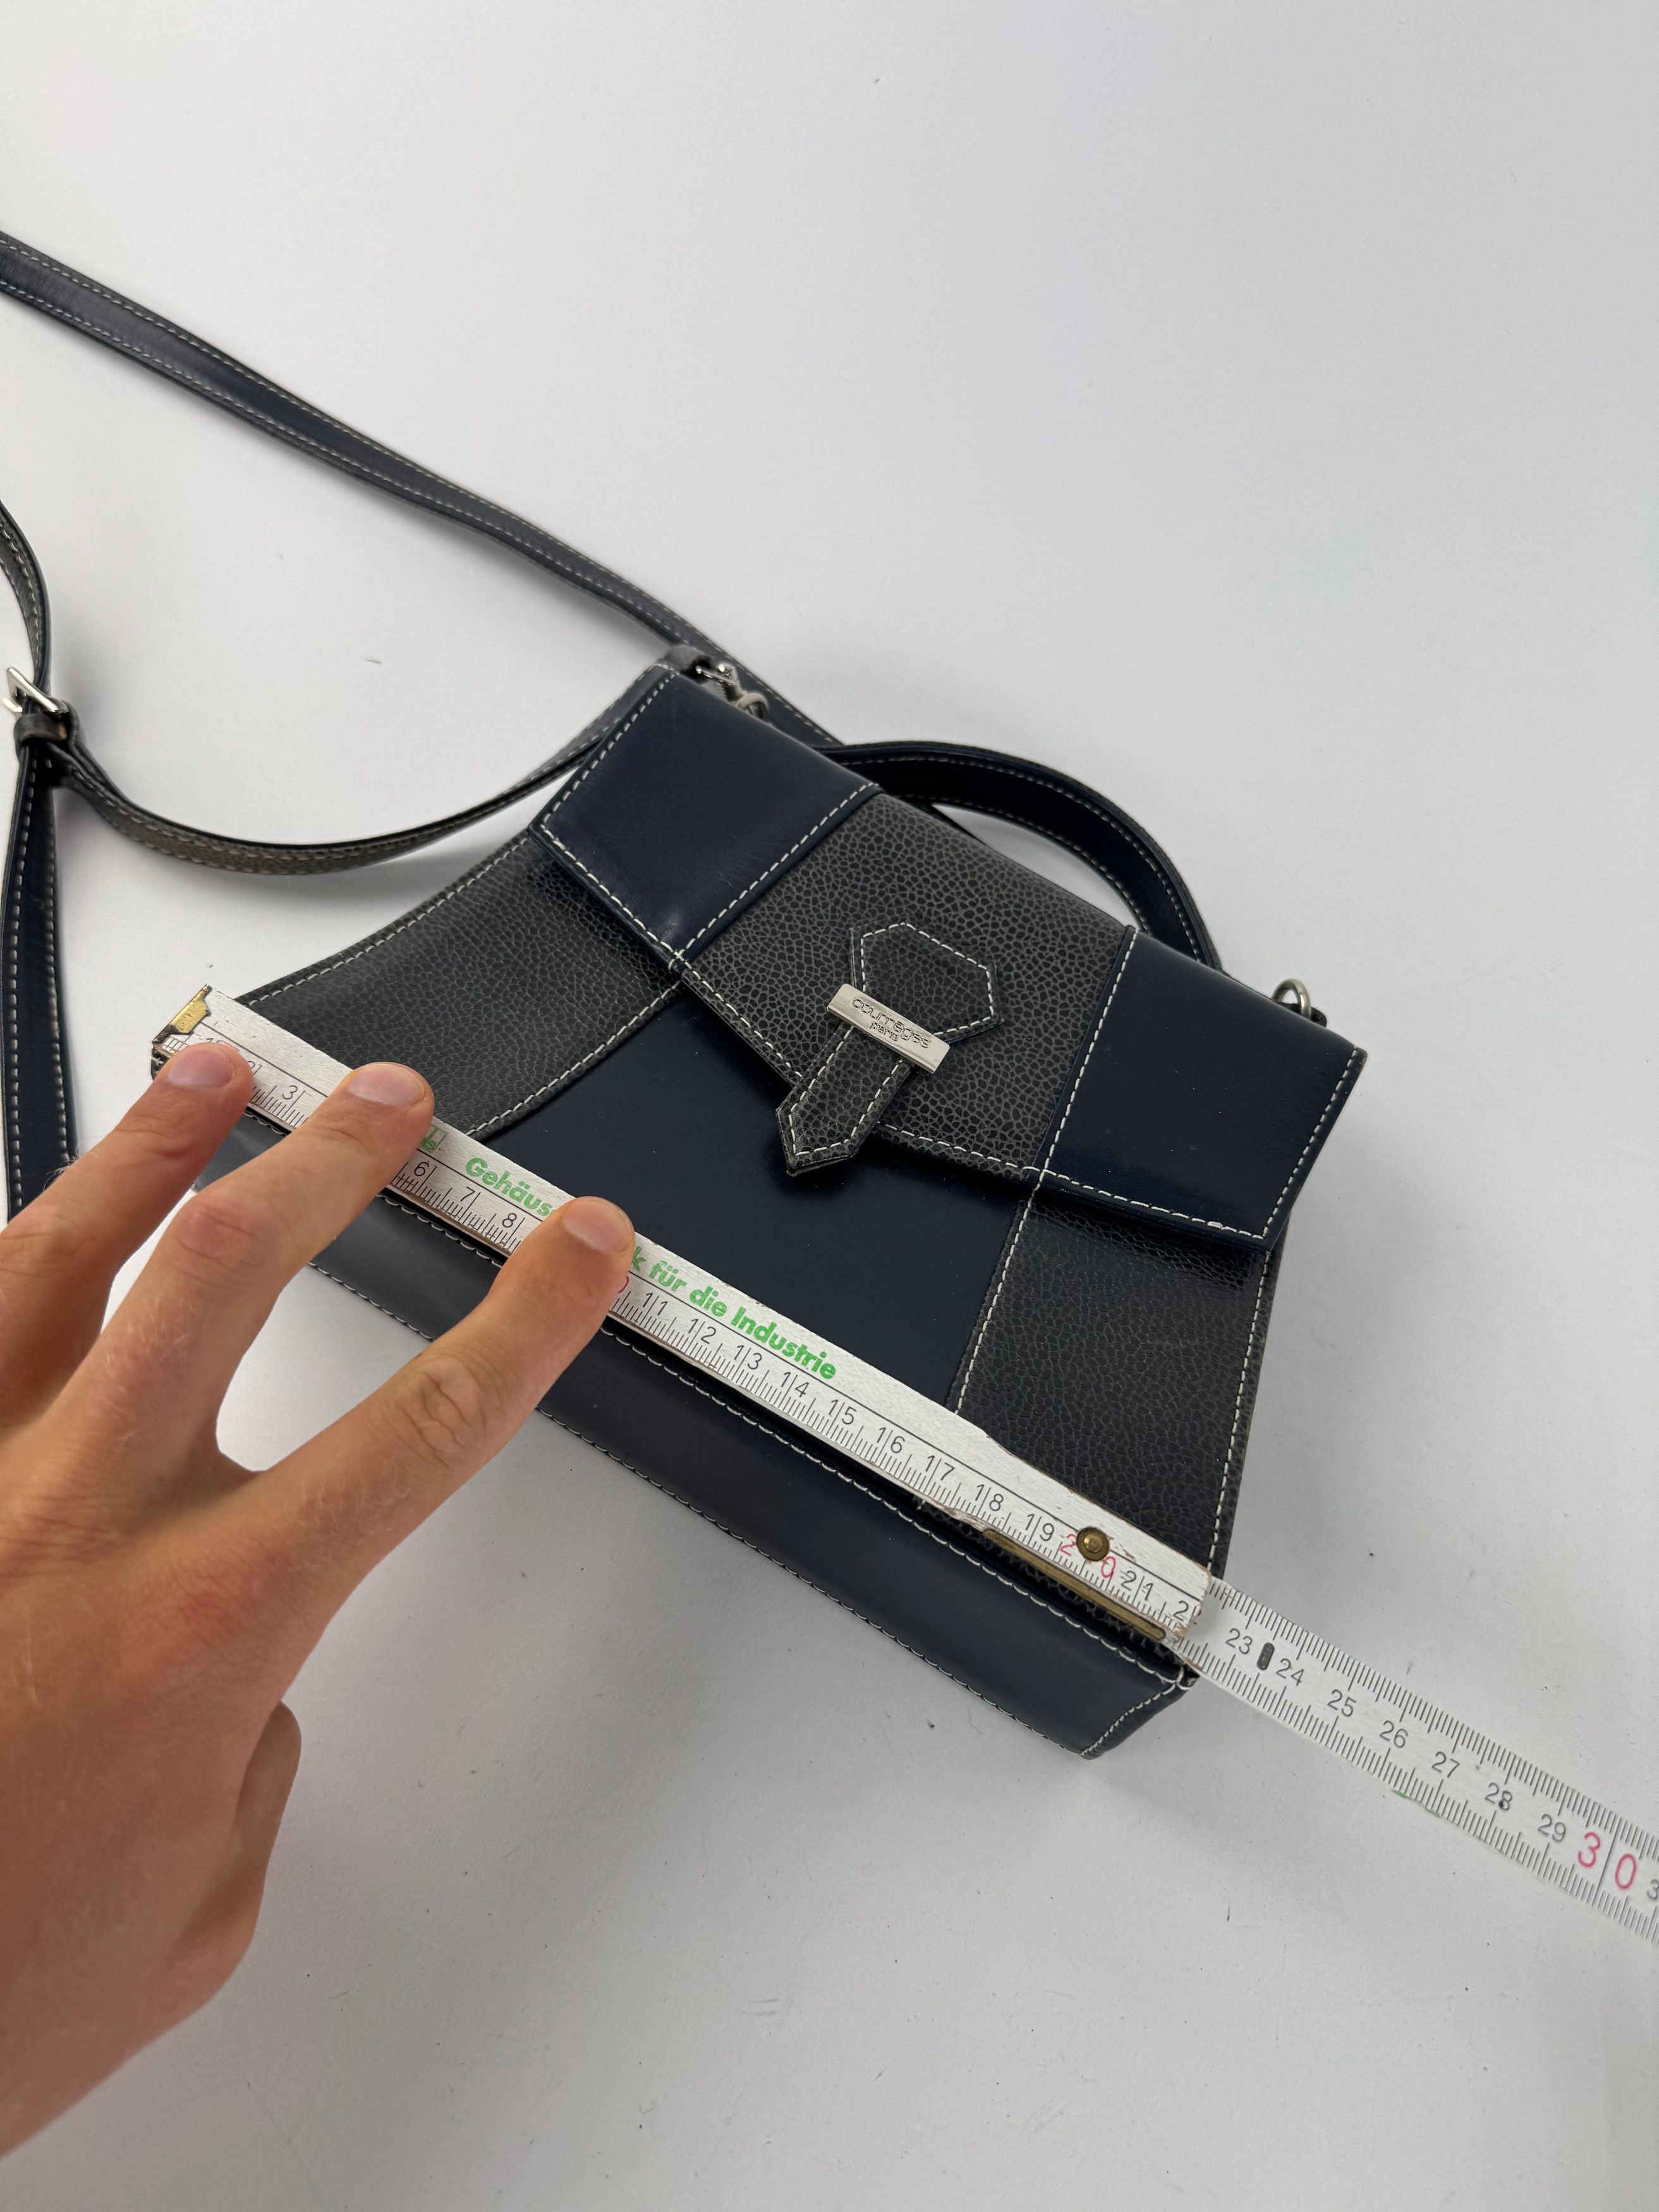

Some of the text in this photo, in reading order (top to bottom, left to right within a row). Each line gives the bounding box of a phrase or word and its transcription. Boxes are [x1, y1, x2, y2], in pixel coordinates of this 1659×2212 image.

[282, 1085, 298, 1100] 3
[413, 1161, 429, 1177] 6
[460, 1186, 476, 1203] 7
[501, 1213, 518, 1229] 8
[1225, 1628, 1253, 1655] 23
[1275, 1658, 1305, 1686] 24
[1327, 1689, 1357, 1717] 25
[1379, 1720, 1409, 1749] 26
[1431, 1751, 1461, 1778] 27
[1485, 1782, 1513, 1811] 28
[1537, 1813, 1567, 1843] 29
[1646, 1878, 1659, 1902] 3
[465, 1157, 555, 1217] Gehäus
[631, 1246, 648, 1272] k
[648, 1260, 688, 1293] für
[689, 1285, 728, 1318] die
[730, 1306, 837, 1380] Industrie
